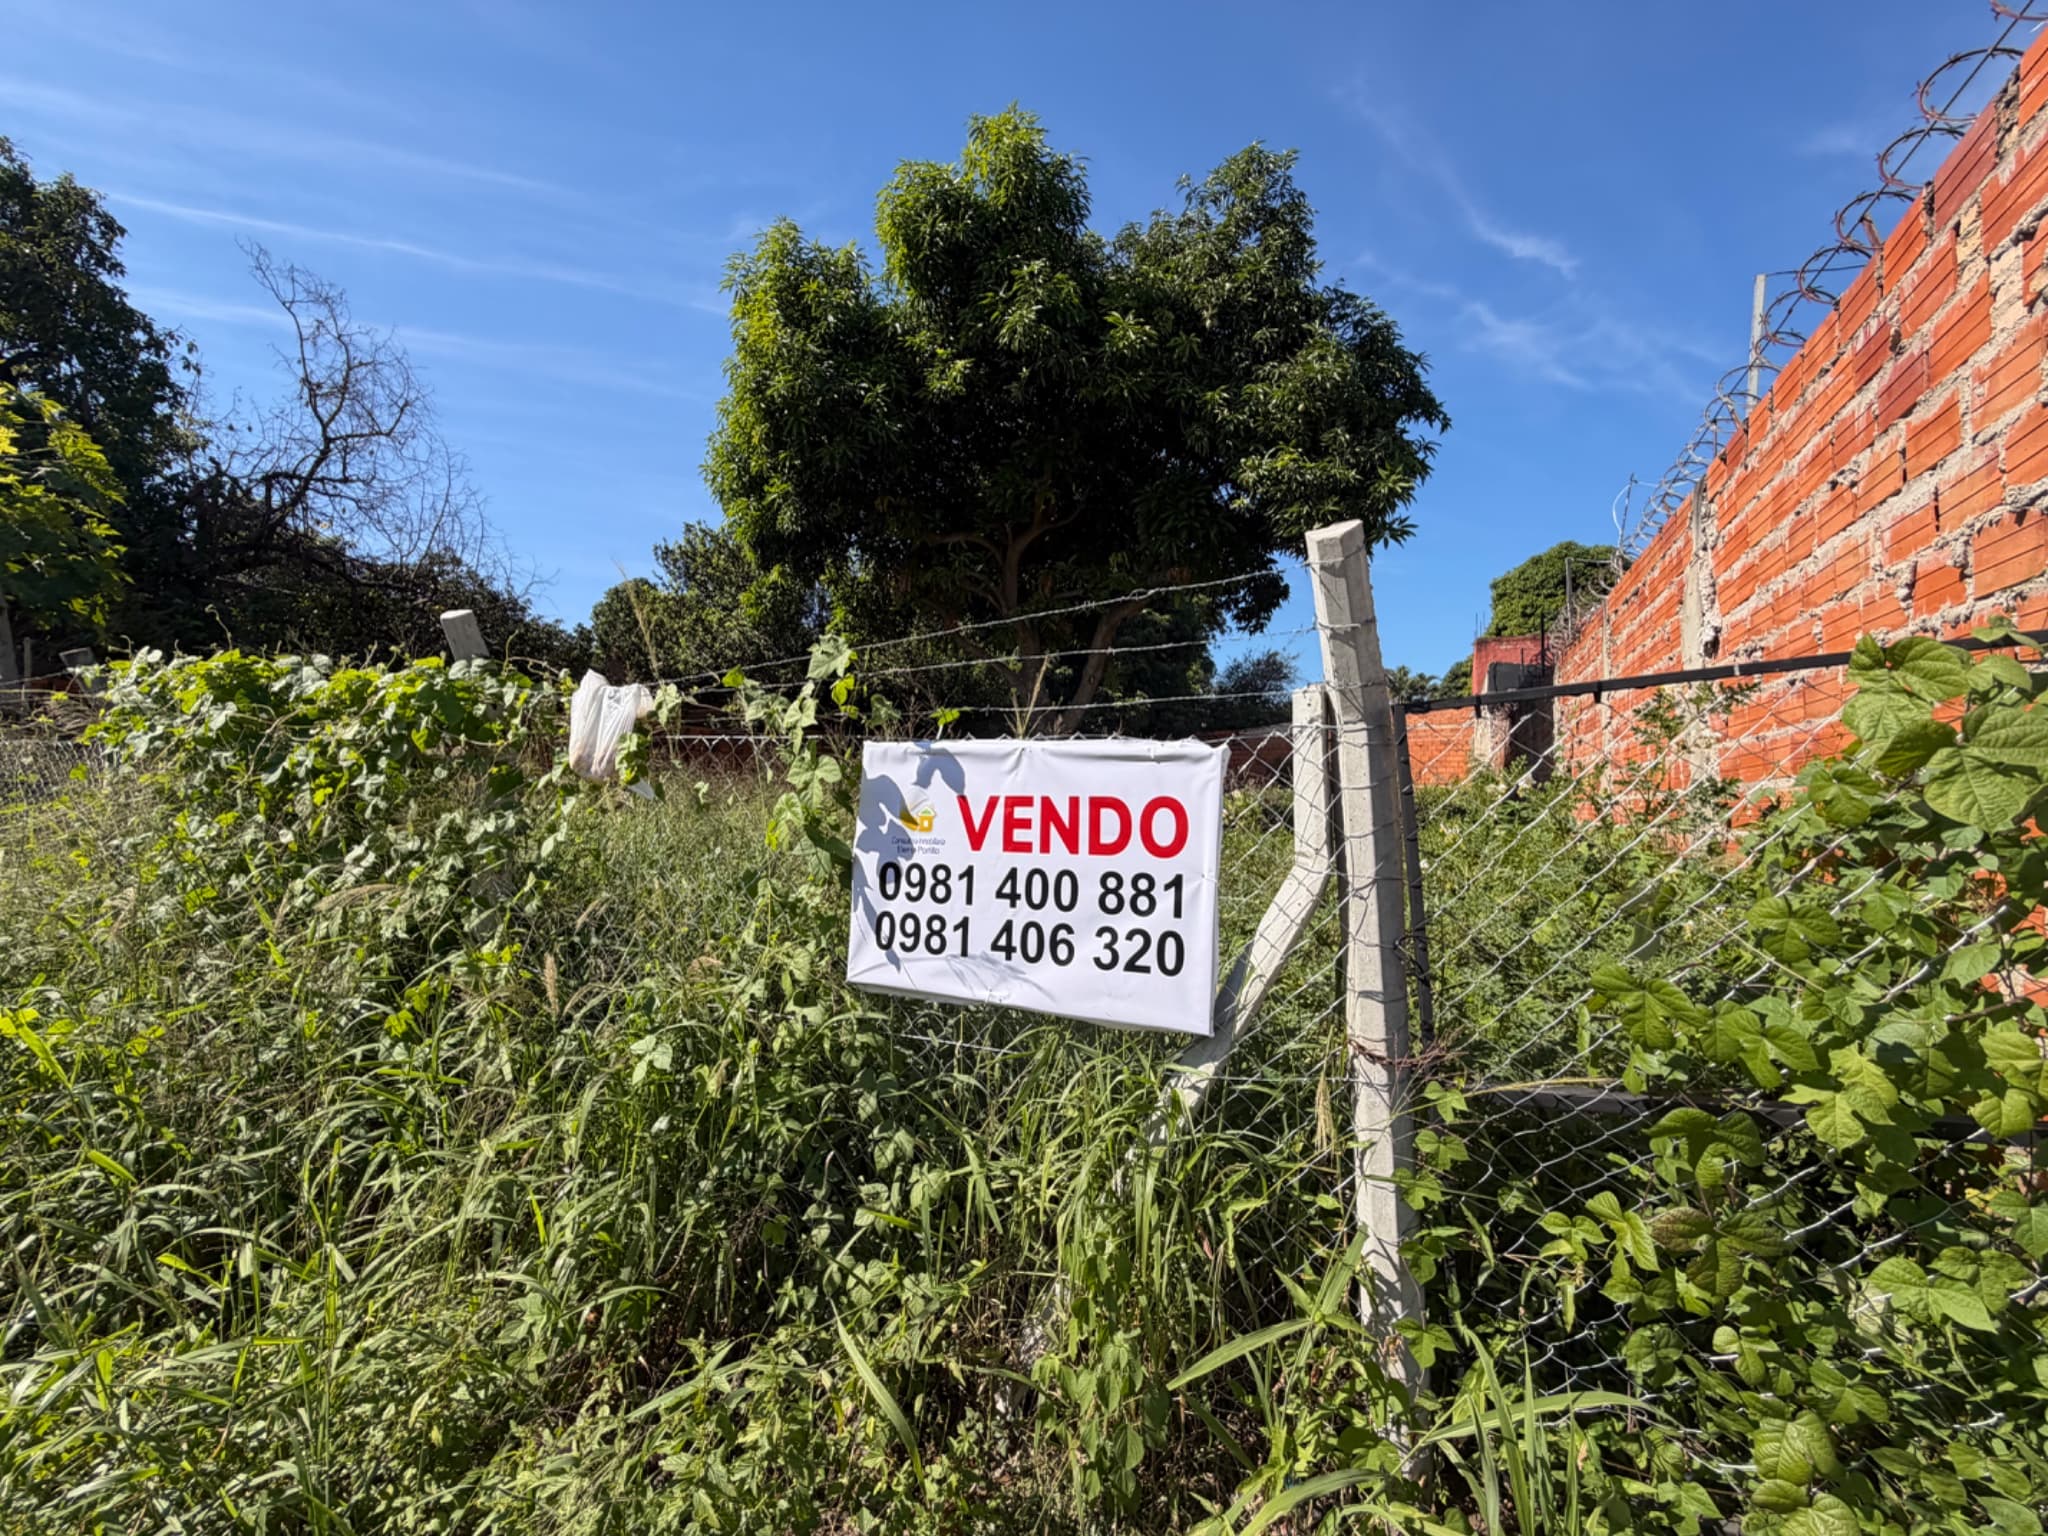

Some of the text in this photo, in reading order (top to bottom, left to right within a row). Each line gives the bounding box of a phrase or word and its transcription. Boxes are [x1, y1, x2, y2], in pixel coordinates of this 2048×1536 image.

[957, 794, 1189, 859] VENDO
[878, 861, 1183, 919] 0981 400 881
[874, 911, 1185, 977] 0981 406 320
